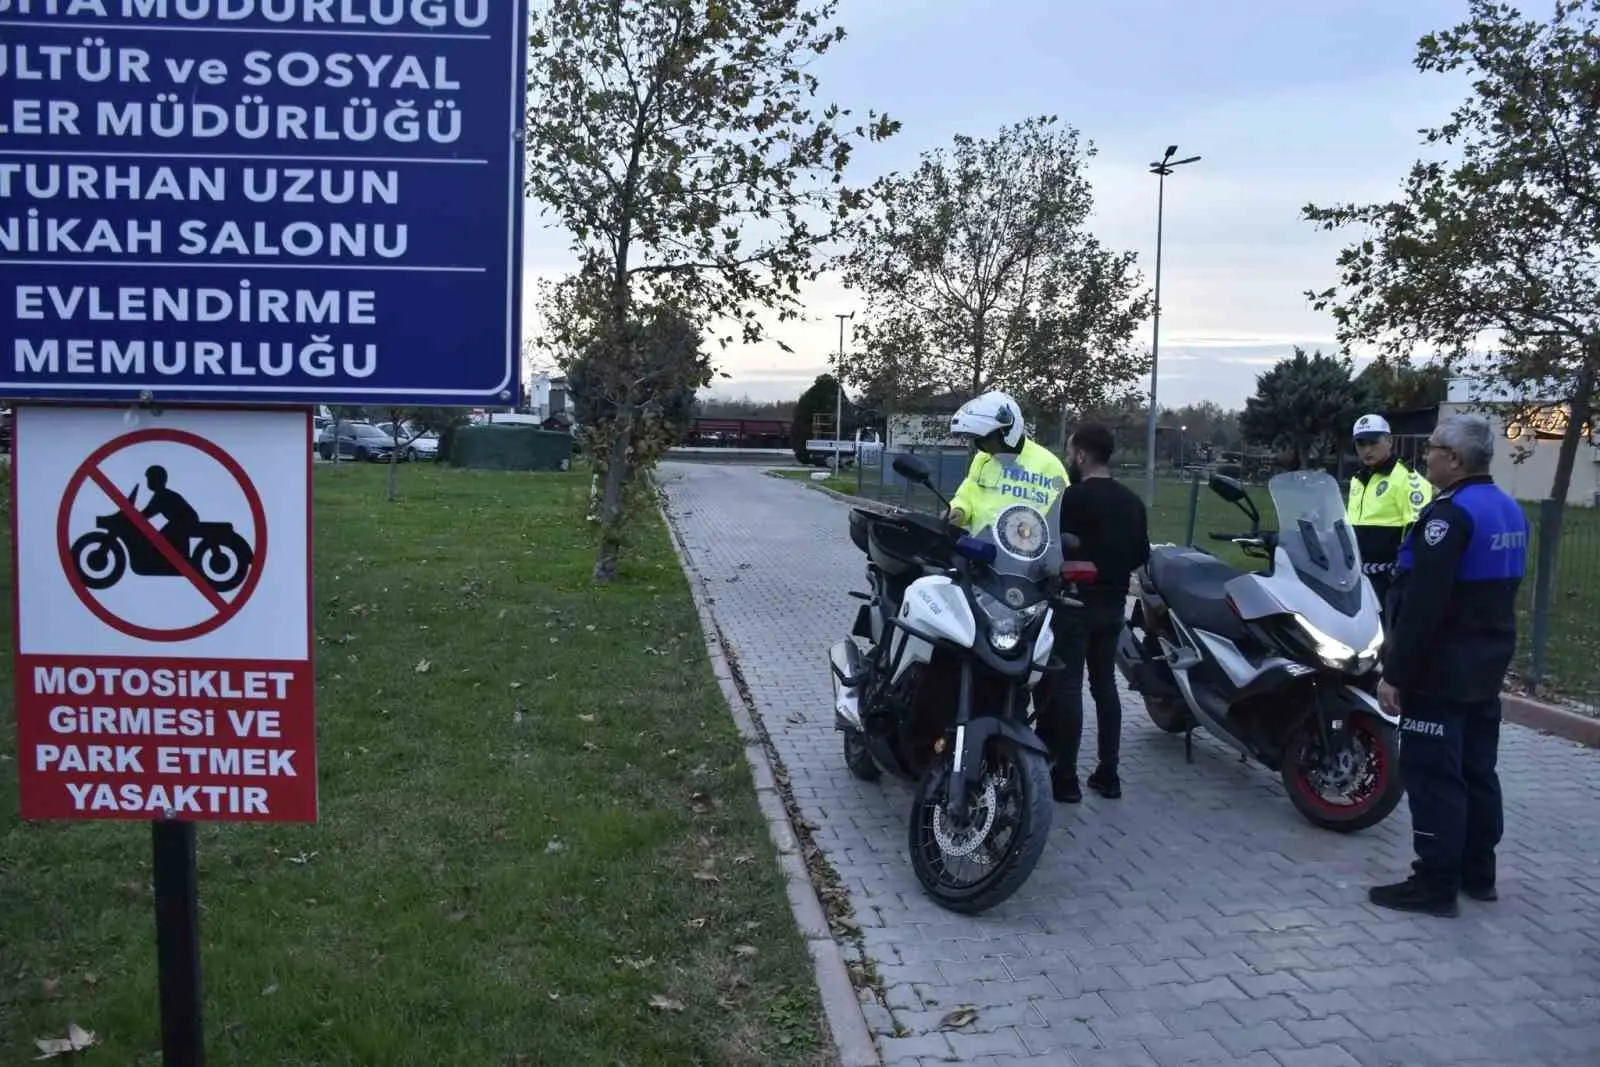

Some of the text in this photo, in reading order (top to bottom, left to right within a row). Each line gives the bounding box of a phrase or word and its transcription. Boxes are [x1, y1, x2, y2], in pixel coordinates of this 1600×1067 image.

[0, 37, 460, 90] LTÜR ve SOSYAL
[97, 93, 462, 143] MÜDÜRLÜĞÜ
[0, 163, 398, 204] TURHAN UZUN
[0, 208, 407, 258] NİKAH SALONU
[16, 279, 376, 324] EVLENDİRME
[14, 334, 377, 378] MEMURLUĞU
[227, 710, 281, 738] VE
[1402, 718, 1444, 736] ZABITA
[36, 744, 297, 777] PARK ETMEK
[65, 782, 270, 814] YASAKTIR
